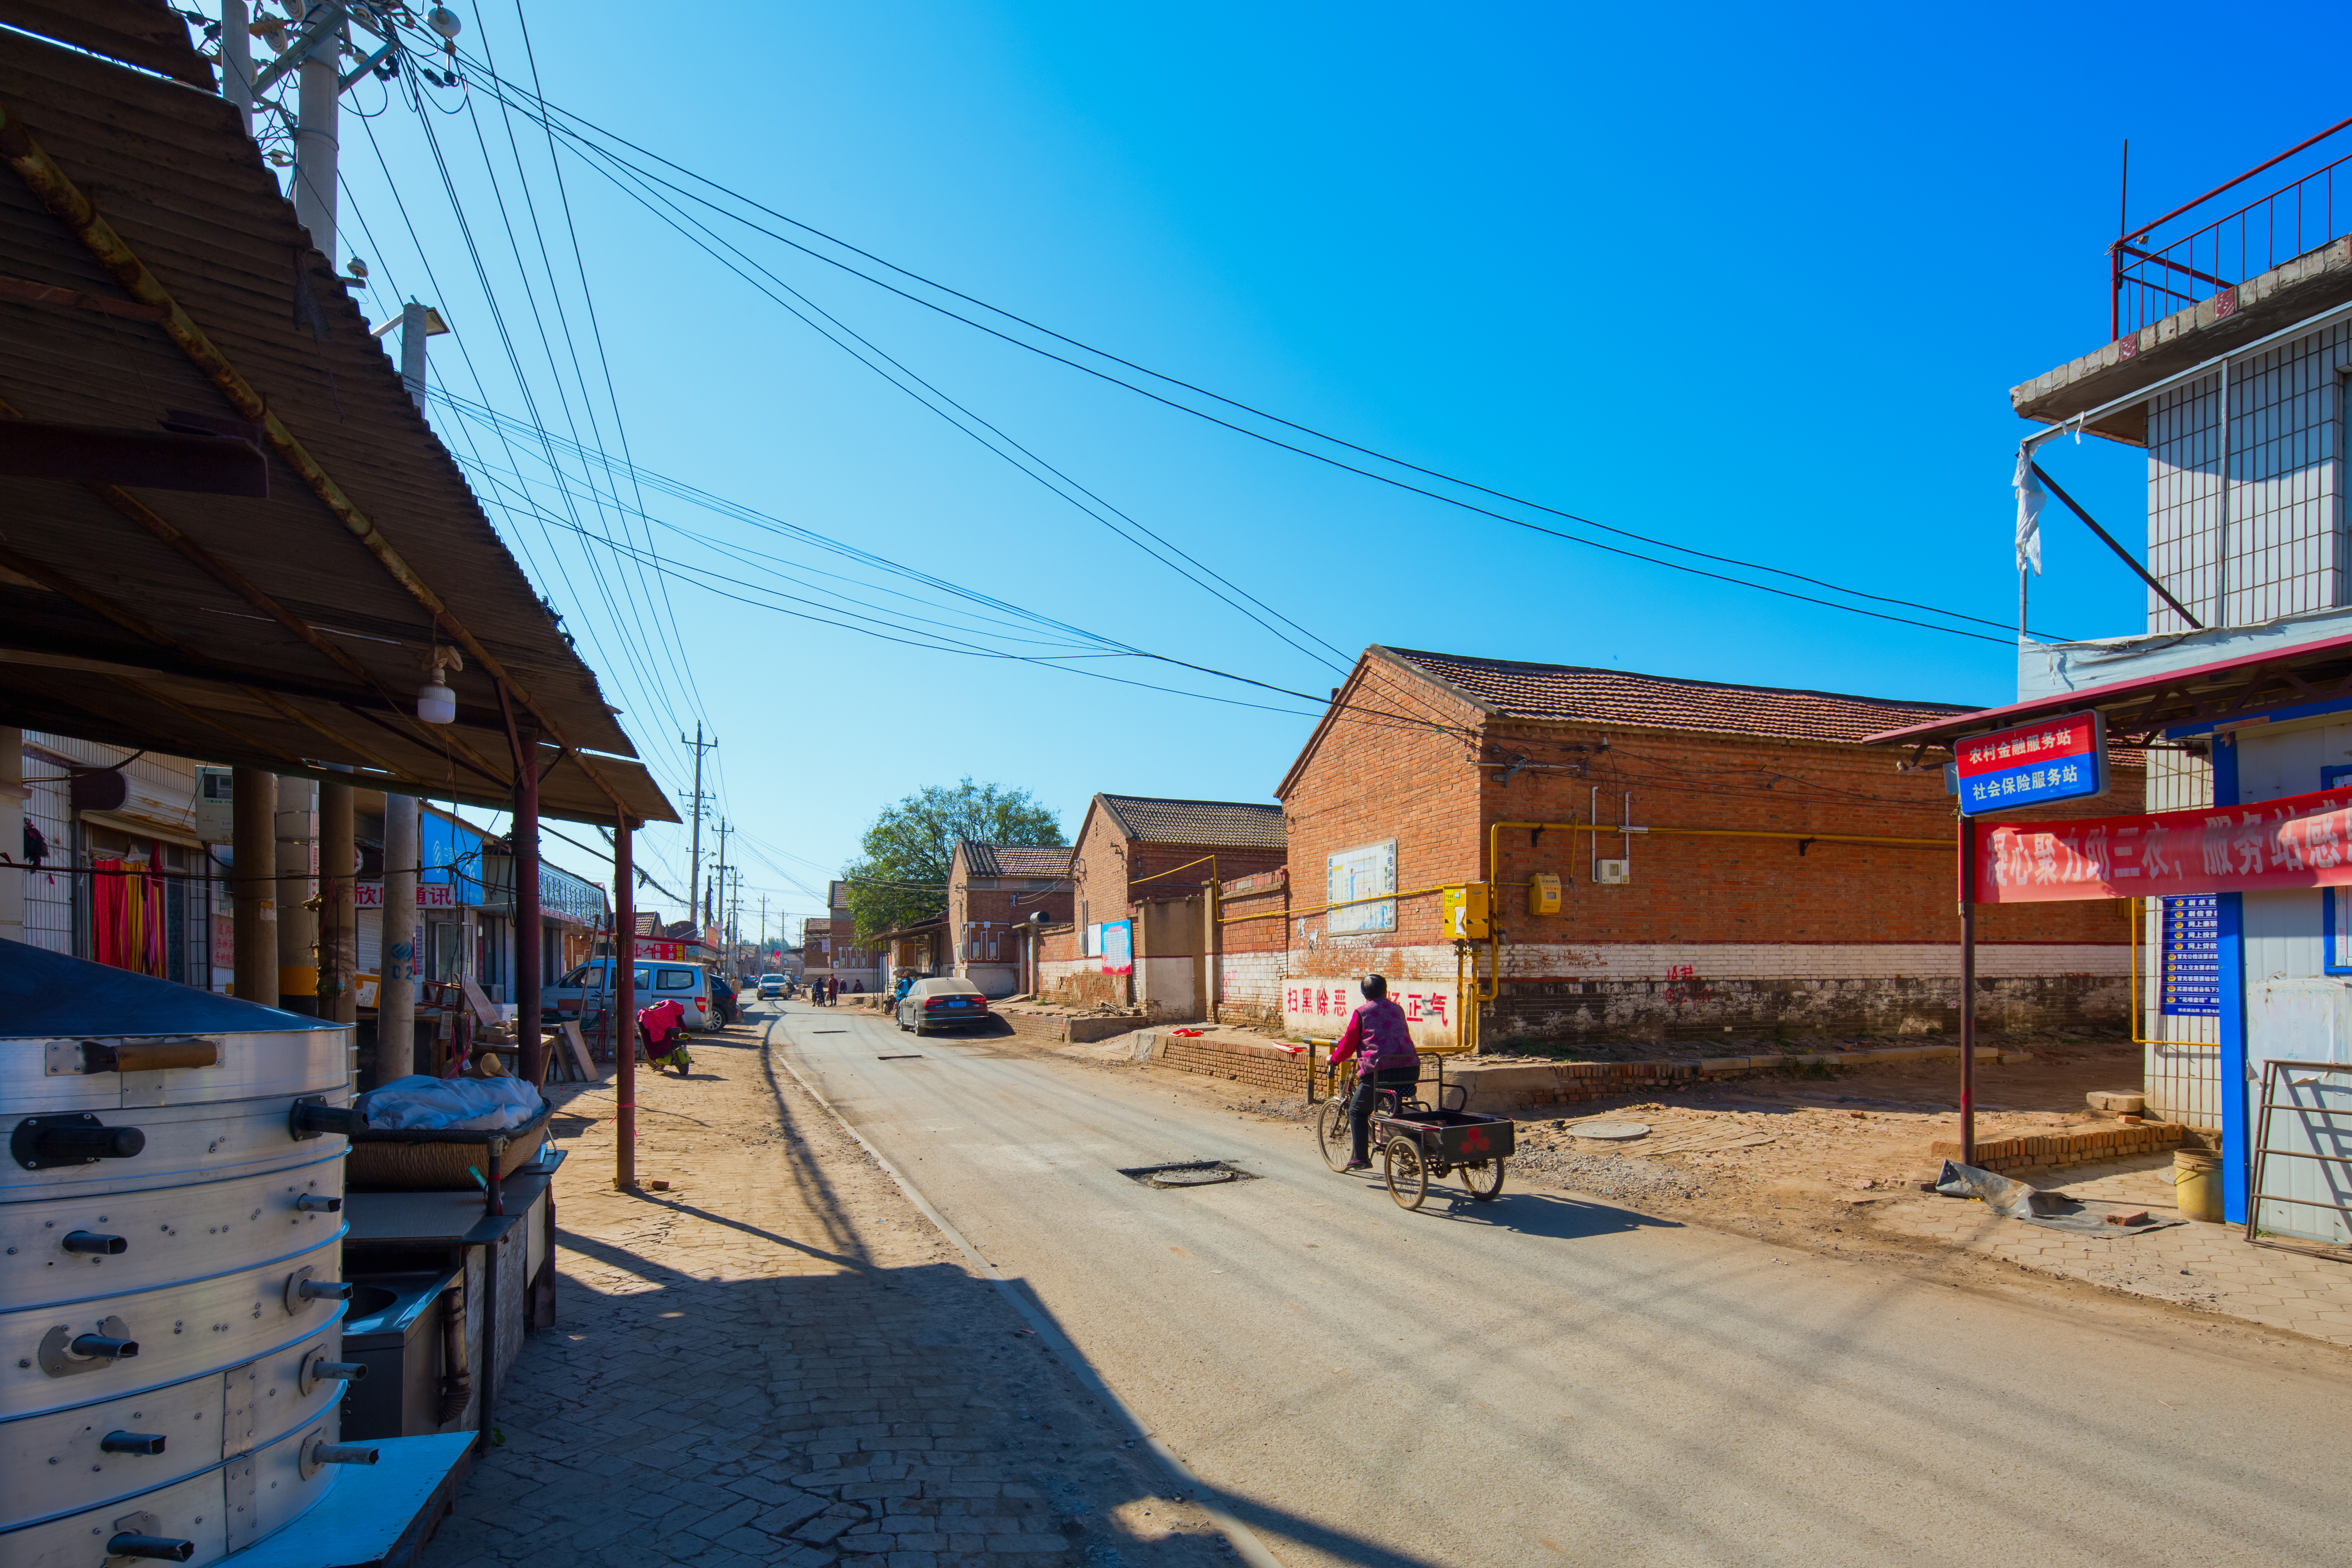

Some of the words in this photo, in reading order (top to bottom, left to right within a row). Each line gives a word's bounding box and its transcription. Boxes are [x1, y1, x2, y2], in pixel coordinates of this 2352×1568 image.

[1969, 728, 2071, 764] 农村金融服务站
[1972, 765, 2077, 801] 社会保险服务站
[1986, 799, 2352, 887] 凝心聚力助三农，服务站感
[355, 884, 451, 905] 欣通讯
[1667, 964, 1693, 980] 18#
[1288, 988, 1347, 1017] 扫黑除恶
